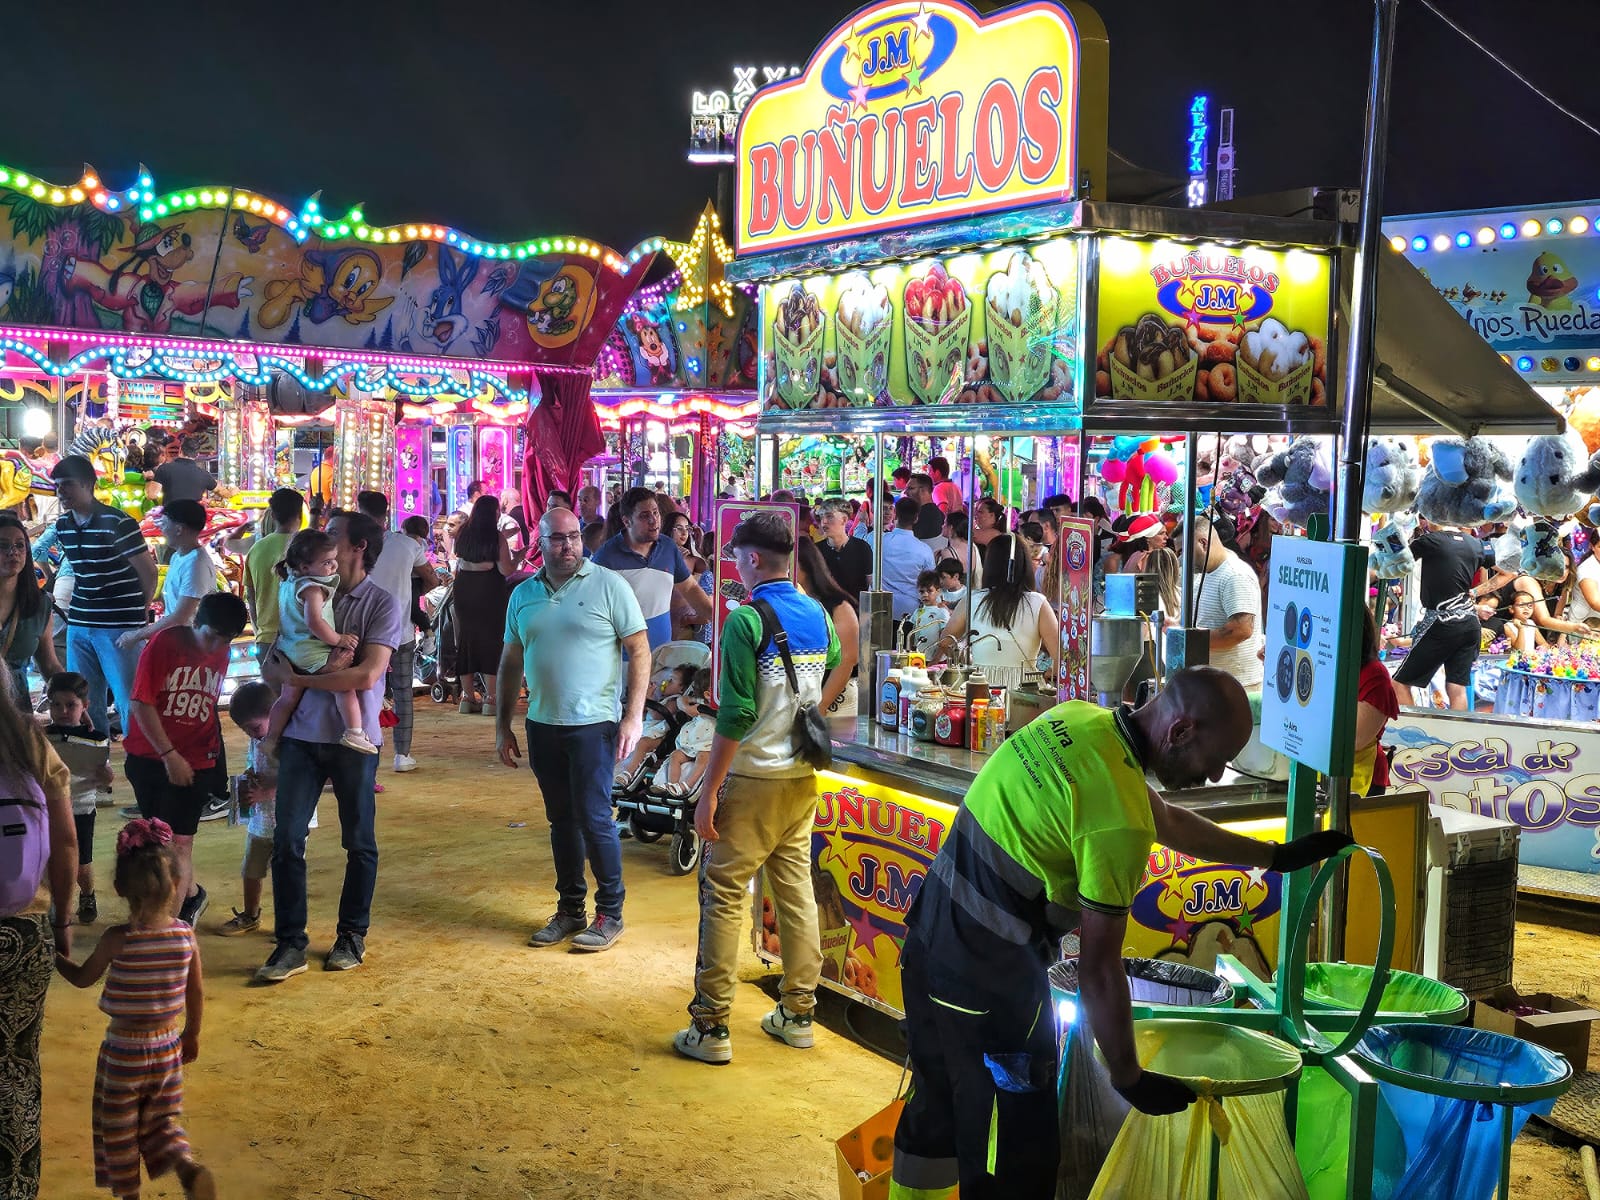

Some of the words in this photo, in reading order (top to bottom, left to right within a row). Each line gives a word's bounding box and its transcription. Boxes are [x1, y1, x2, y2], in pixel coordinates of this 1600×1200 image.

[863, 27, 912, 77] J.M
[748, 66, 1061, 236] BUÑUELOS
[1187, 96, 1207, 172] REMIX
[1150, 250, 1279, 293] BUÑUELOS
[1196, 284, 1238, 310] J.M
[1466, 309, 1520, 339] nos.
[1278, 565, 1329, 594] SELECTIVA
[163, 692, 213, 722] 1985
[1048, 719, 1073, 749] Aira
[1391, 737, 1511, 781] esca
[1522, 740, 1579, 772] de
[1386, 773, 1600, 830] atos
[1184, 878, 1243, 915] J.M
[820, 932, 848, 950] ñuelos
